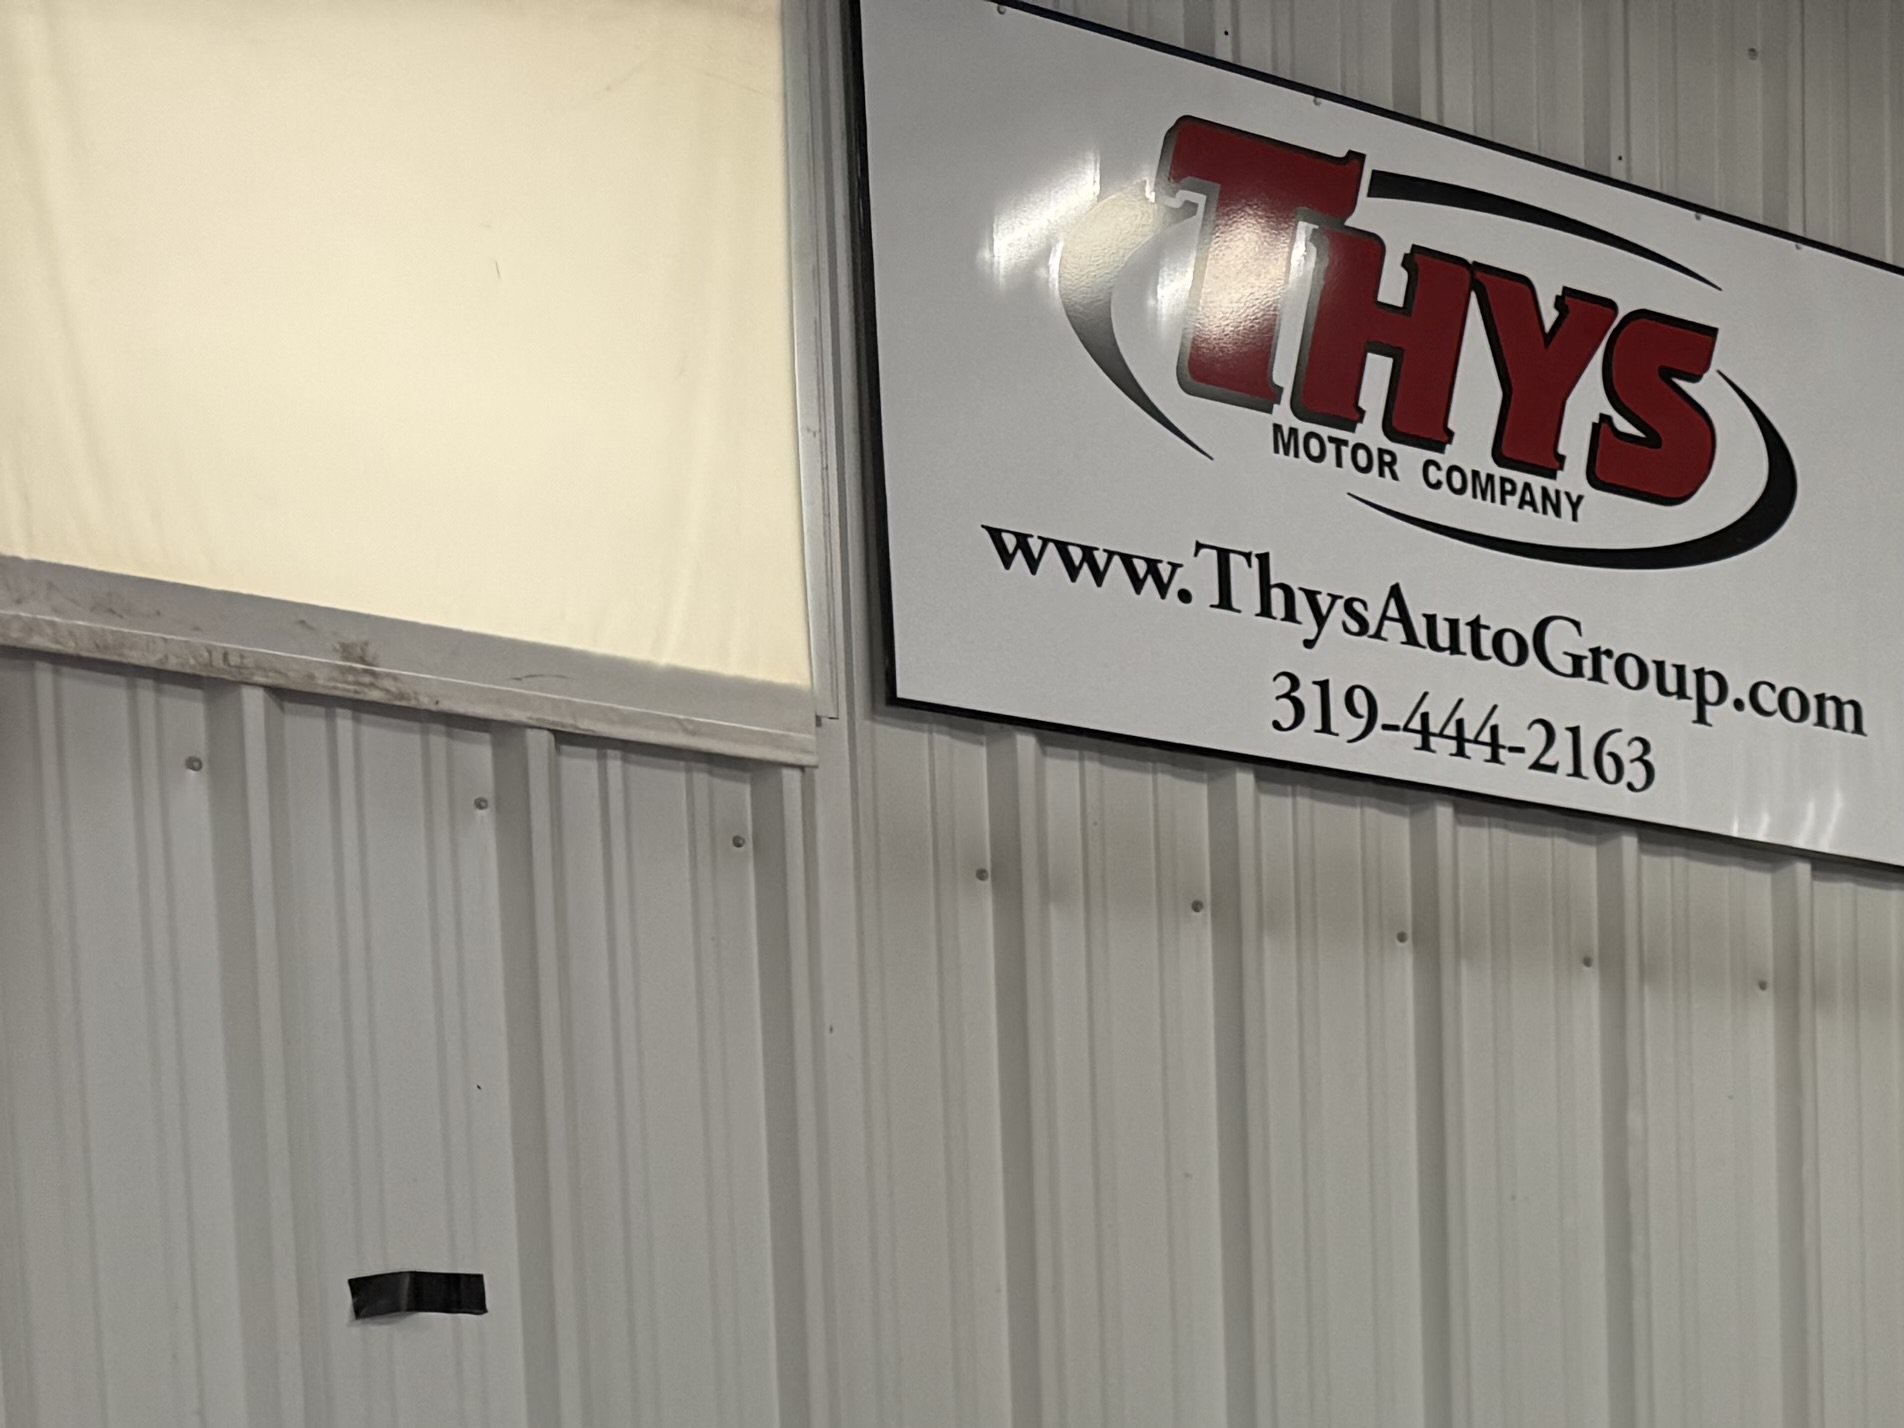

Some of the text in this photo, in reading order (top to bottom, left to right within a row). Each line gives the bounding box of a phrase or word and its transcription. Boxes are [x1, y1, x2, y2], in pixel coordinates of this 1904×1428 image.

[1156, 114, 1719, 507] THYS
[1272, 422, 1584, 522] MOTOR COMPANY
[981, 525, 1866, 736] www.ThysAutoGroup.com
[1271, 671, 1655, 793] 319-444-2163
